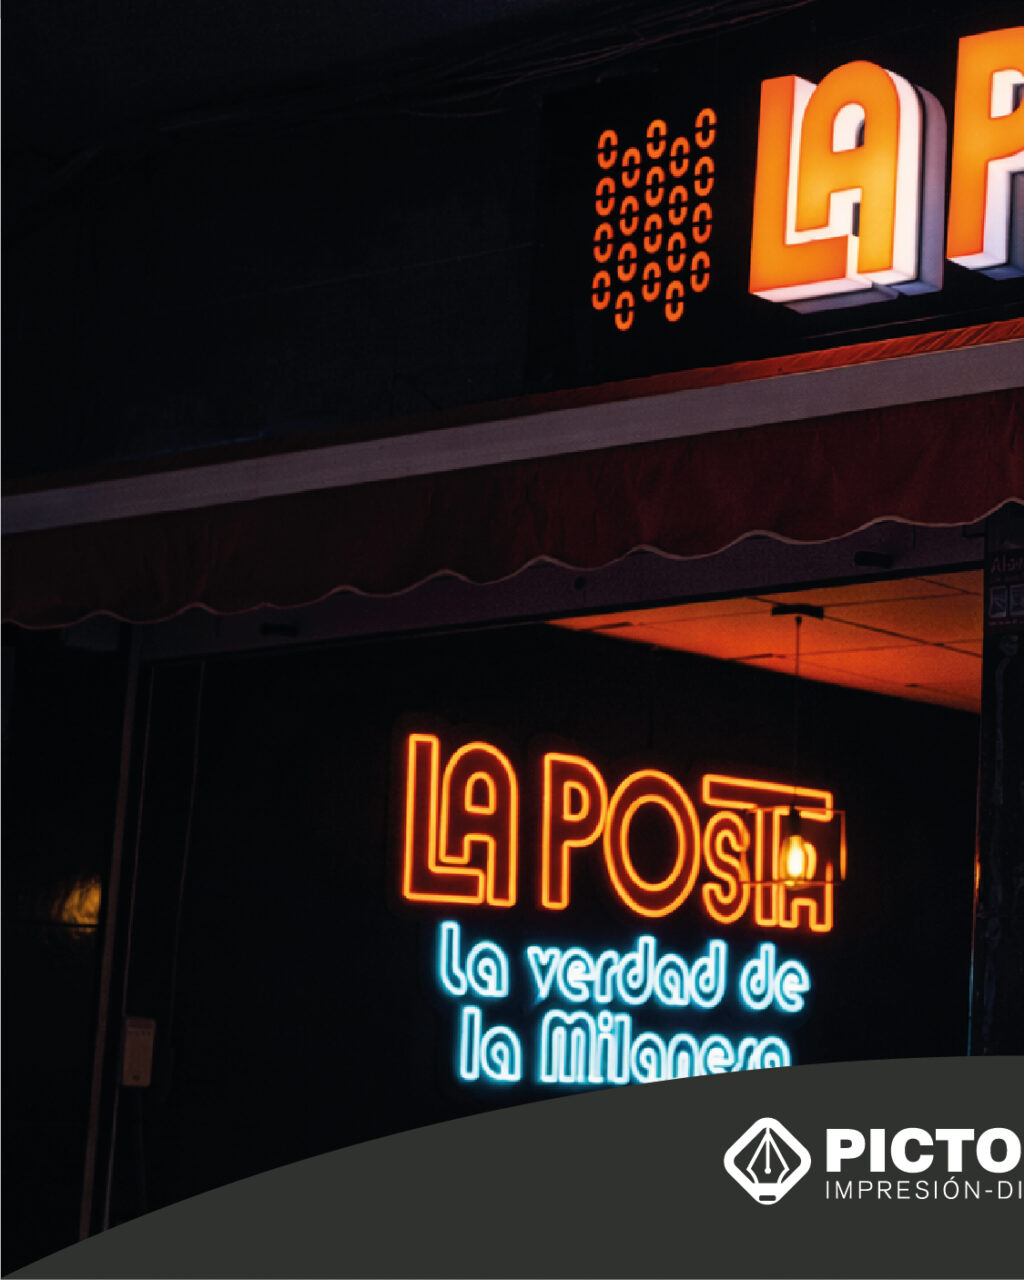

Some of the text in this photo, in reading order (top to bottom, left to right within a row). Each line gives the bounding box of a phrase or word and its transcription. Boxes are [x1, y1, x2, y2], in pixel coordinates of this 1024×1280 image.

[748, 60, 926, 302] LA
[403, 733, 518, 908] LA
[440, 921, 811, 1012] La verdad de
[460, 1007, 521, 1082] la
